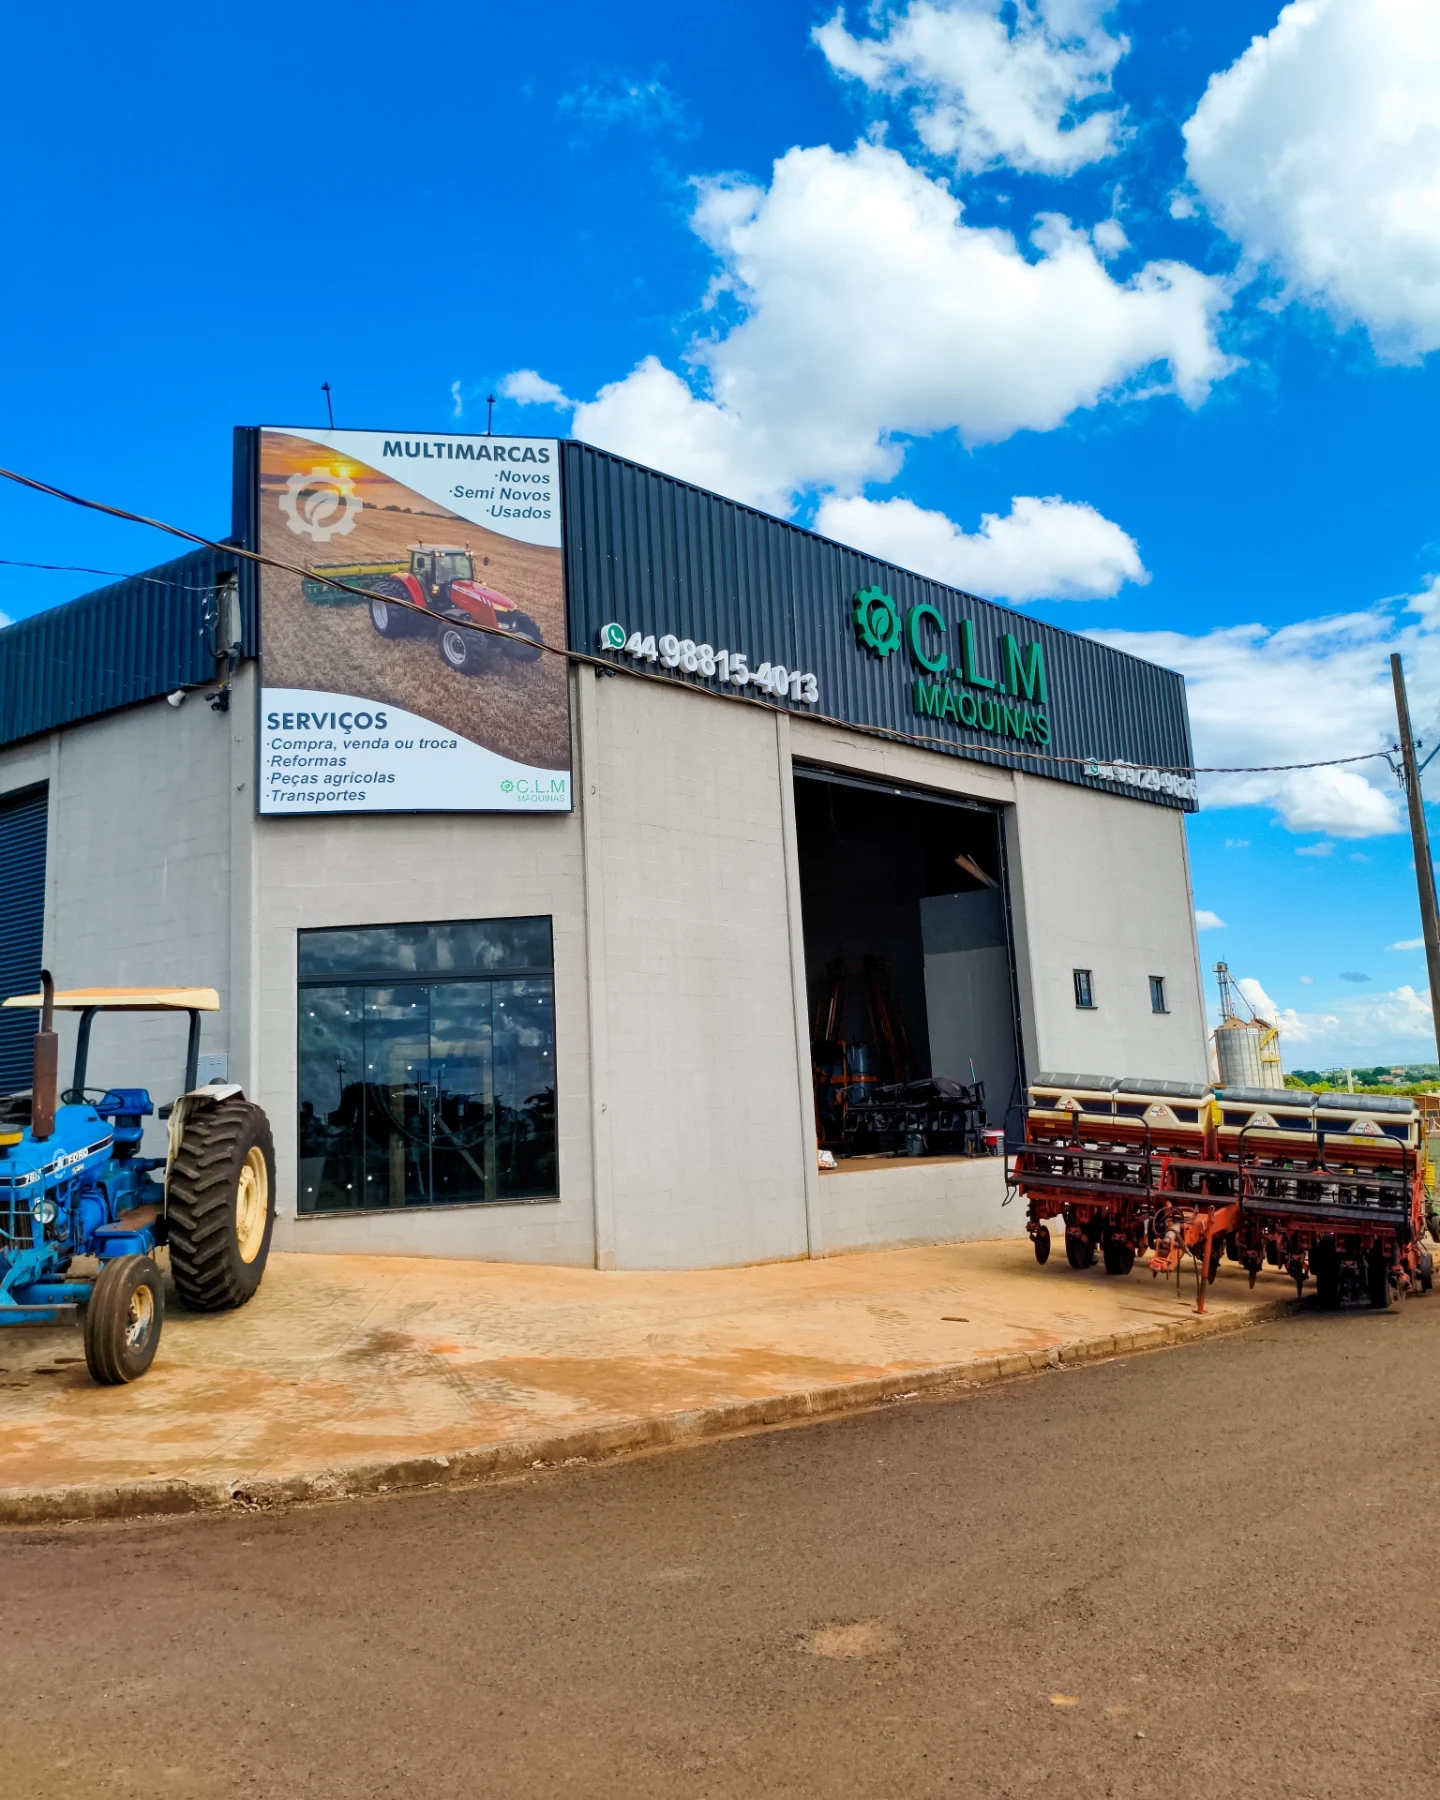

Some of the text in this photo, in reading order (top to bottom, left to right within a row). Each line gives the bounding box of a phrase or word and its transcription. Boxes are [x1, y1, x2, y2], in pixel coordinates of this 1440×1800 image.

[382, 440, 551, 464] MULTIMARCAS
[499, 470, 551, 484] Novos
[453, 485, 552, 501] Semi Novos
[490, 505, 552, 519] Usados
[906, 603, 1047, 704] C.L.M
[624, 631, 819, 704] 44 98815-4013
[912, 677, 1051, 746] MÁQUINAS
[267, 712, 388, 735] SERVIÇOS
[343, 738, 390, 750] venda
[394, 740, 414, 749] ou
[419, 738, 458, 750] troca
[270, 755, 347, 768] Reformas
[323, 771, 396, 786] agrícolas
[516, 779, 565, 793] C.L.M
[271, 789, 367, 804] Transportes
